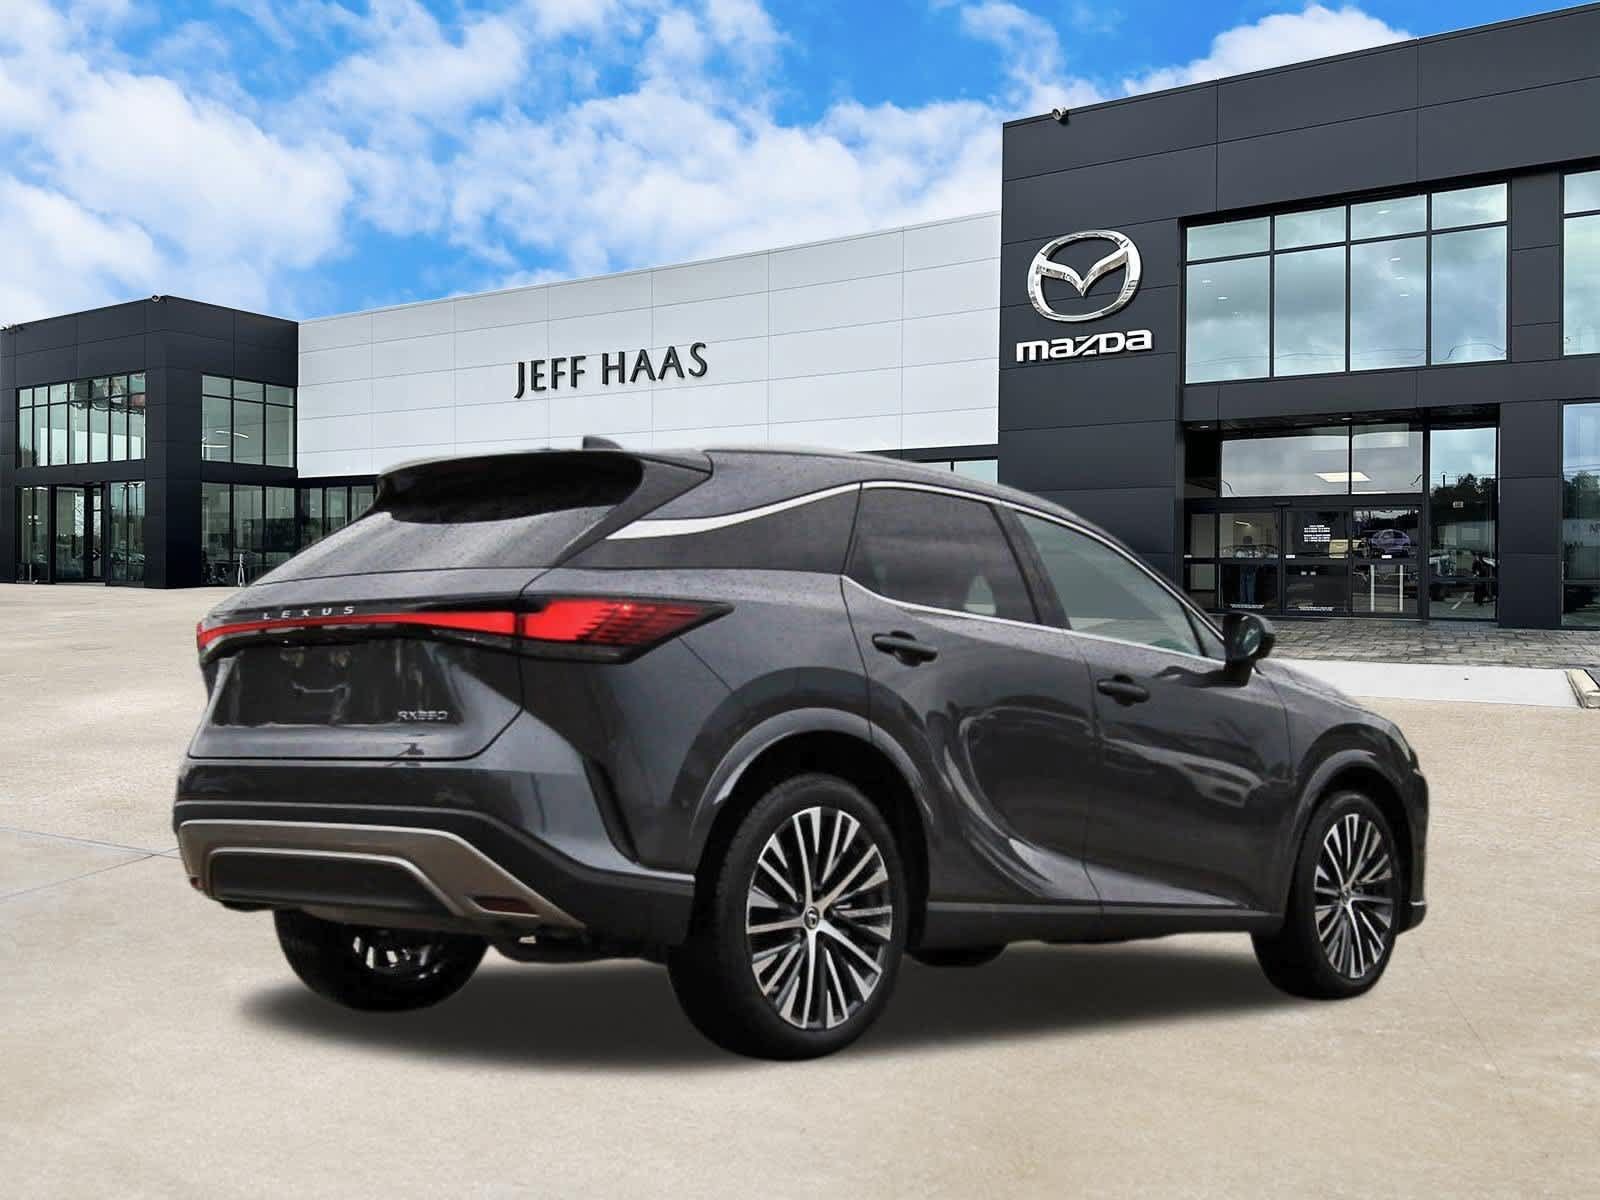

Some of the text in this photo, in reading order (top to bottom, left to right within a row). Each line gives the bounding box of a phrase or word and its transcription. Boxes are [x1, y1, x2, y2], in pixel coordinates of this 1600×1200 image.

[514, 342, 708, 399] JEFF HAAS
[263, 605, 355, 620] LEXUS
